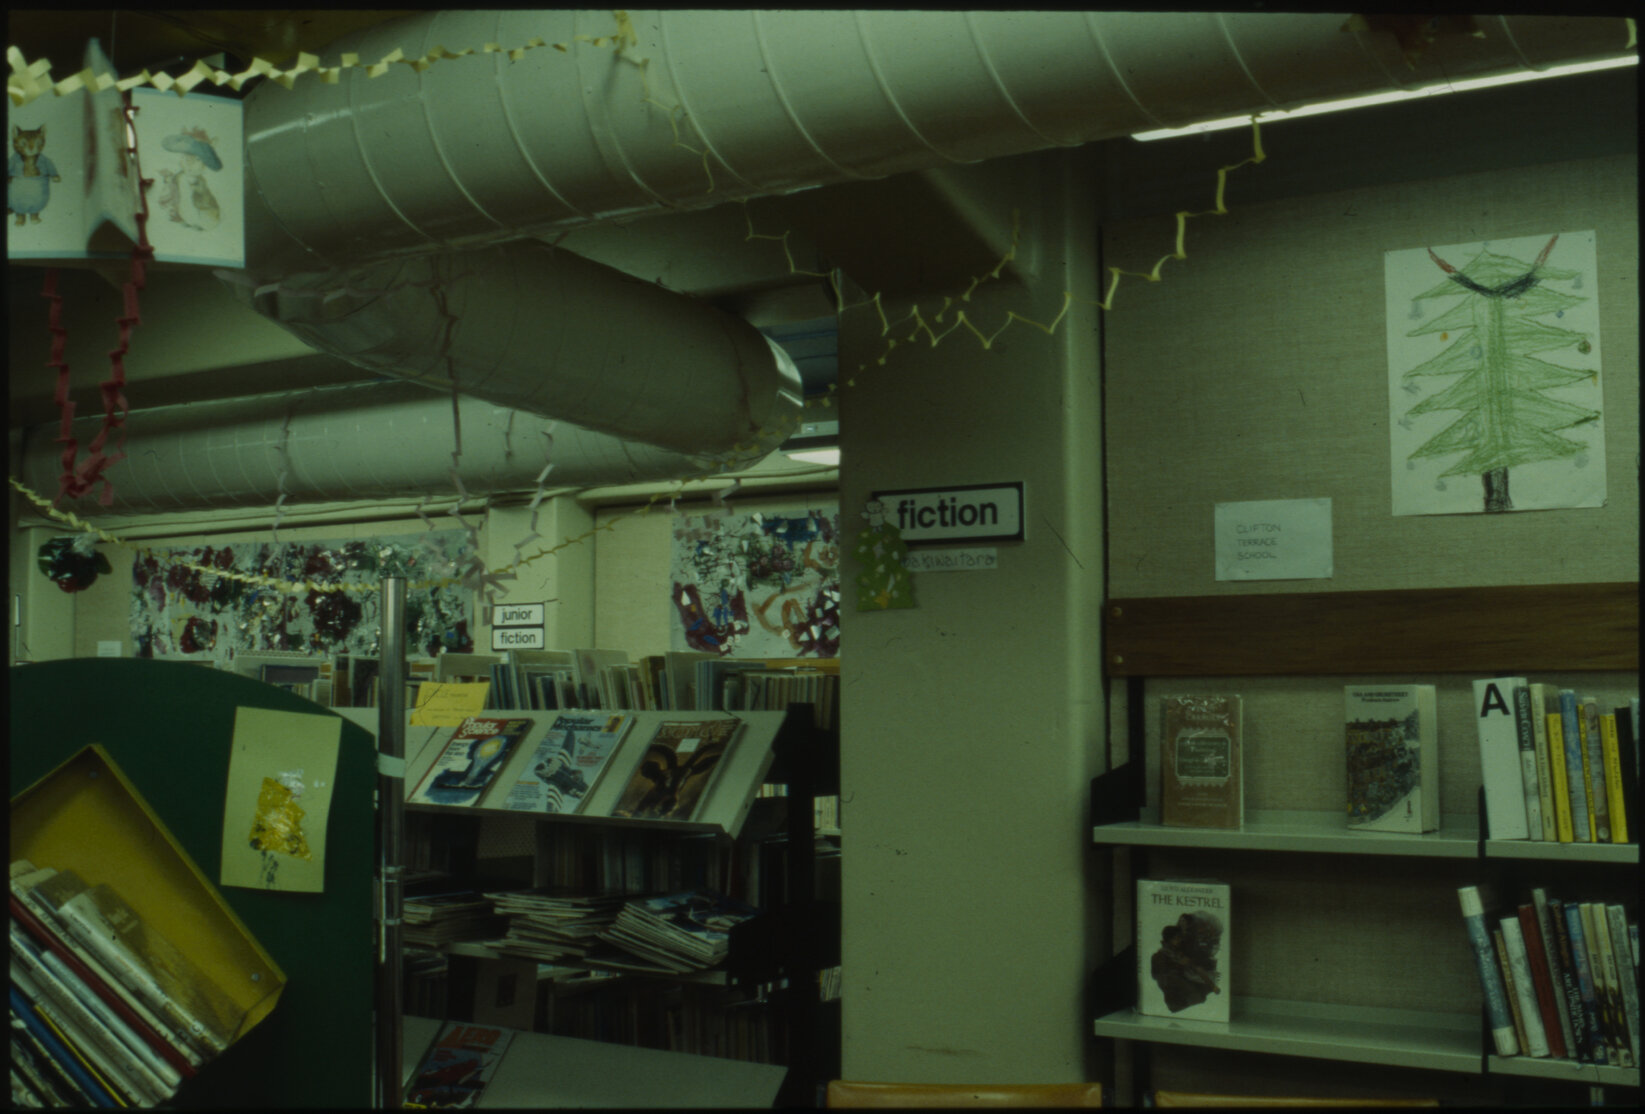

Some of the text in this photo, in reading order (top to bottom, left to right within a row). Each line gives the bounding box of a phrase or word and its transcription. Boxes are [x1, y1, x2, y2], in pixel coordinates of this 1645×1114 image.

[897, 497, 998, 529] fiction
[1236, 523, 1281, 534] CLIFTON
[1237, 551, 1278, 561] SCHOOL
[502, 608, 532, 624] junior
[500, 632, 536, 643] fiction
[1480, 683, 1511, 717] A
[1151, 894, 1224, 909] THE KESTREL
